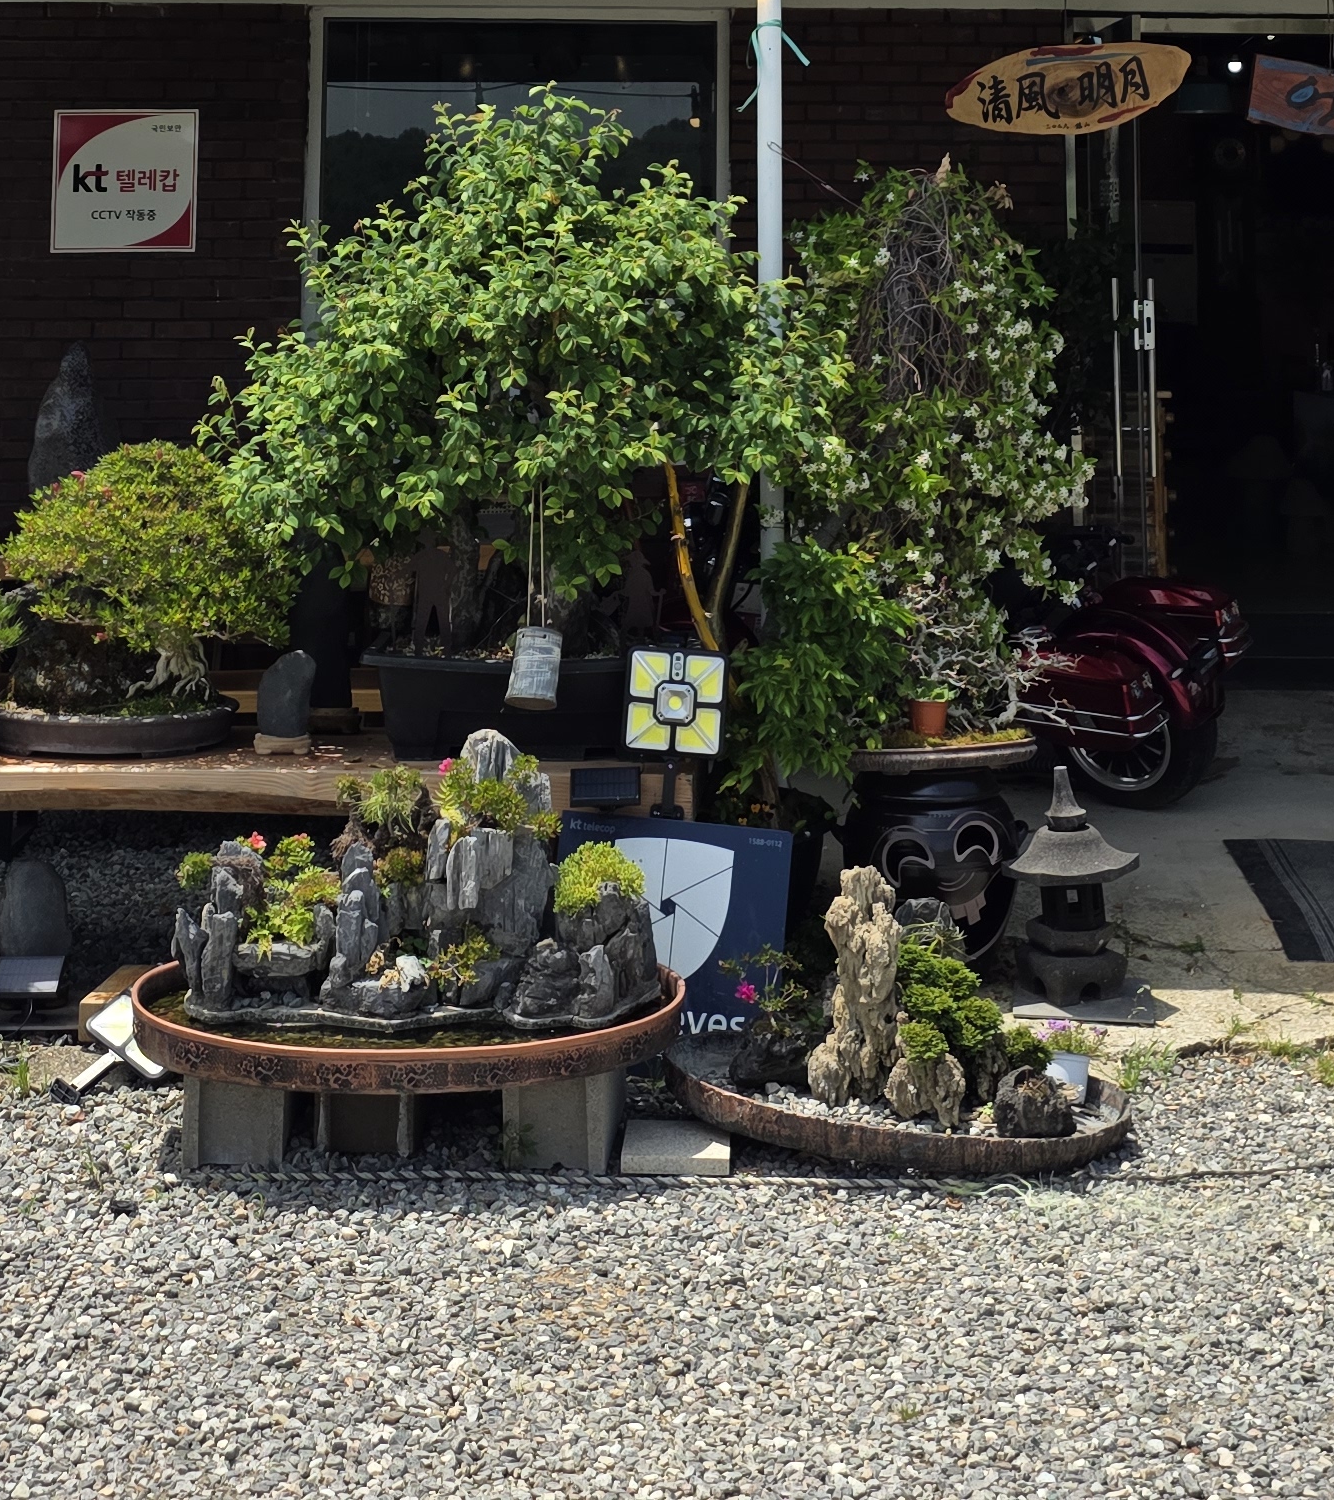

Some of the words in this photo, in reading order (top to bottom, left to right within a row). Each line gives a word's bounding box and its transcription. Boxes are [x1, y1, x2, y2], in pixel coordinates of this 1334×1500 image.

[72, 163, 109, 193] kt
[115, 168, 180, 193] 텔레캅
[91, 210, 122, 220] CCTV
[125, 209, 157, 221] 작동중
[569, 817, 582, 831] kt
[583, 821, 616, 836] telecop
